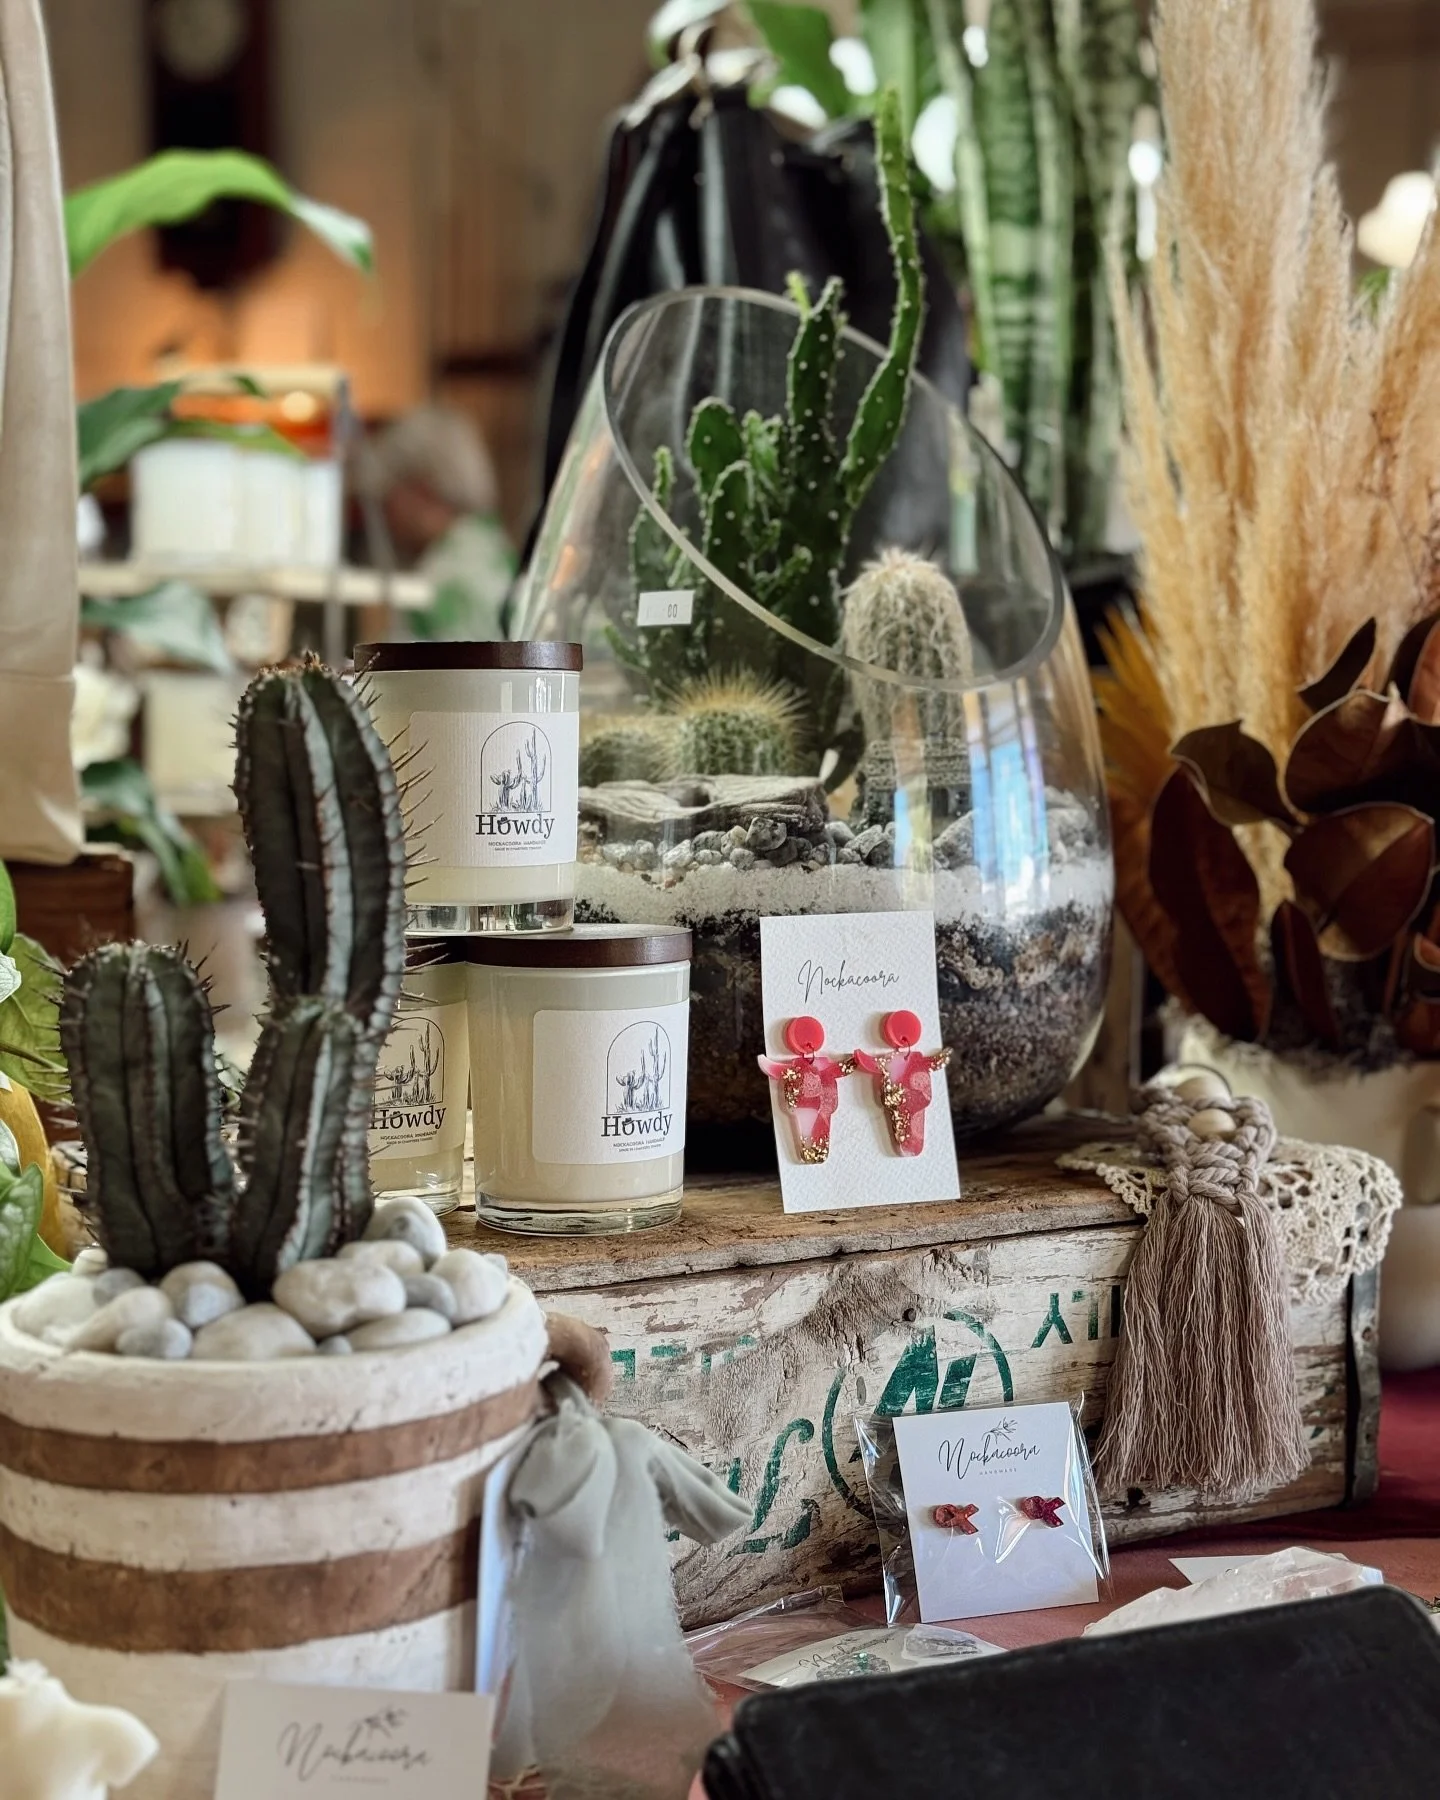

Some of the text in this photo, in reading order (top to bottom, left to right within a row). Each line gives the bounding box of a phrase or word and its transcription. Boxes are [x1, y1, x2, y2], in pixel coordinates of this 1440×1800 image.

[475, 813, 556, 840] Howdy
[797, 959, 900, 1004] Nockacoora
[368, 1105, 447, 1130] Howdy
[600, 1111, 673, 1137] Howdy
[938, 1434, 1041, 1480] Nockacoora
